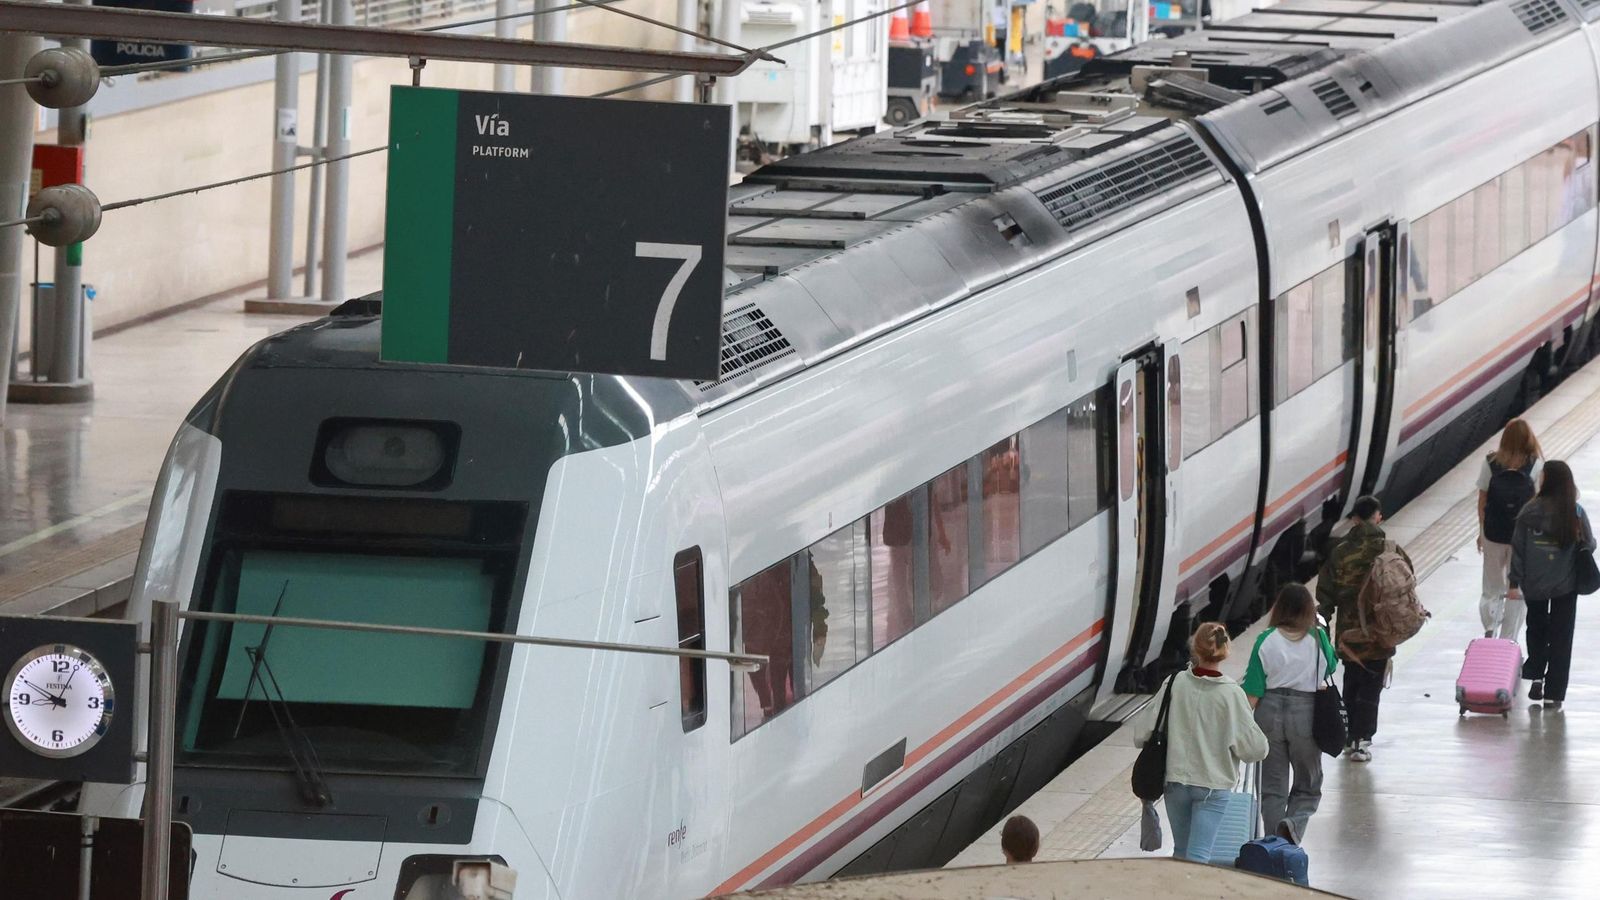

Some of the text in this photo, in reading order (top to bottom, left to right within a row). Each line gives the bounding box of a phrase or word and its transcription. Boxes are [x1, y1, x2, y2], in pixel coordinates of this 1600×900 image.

[116, 42, 165, 57] POLICIA
[475, 113, 510, 137] Vía
[472, 145, 529, 159] PLATFORM
[635, 241, 702, 361] 7
[51, 660, 70, 673] 12
[46, 682, 73, 691] FESTINA
[18, 693, 30, 706] 9
[87, 696, 99, 709] 3
[51, 730, 63, 742] 6
[667, 818, 687, 849] renfe
